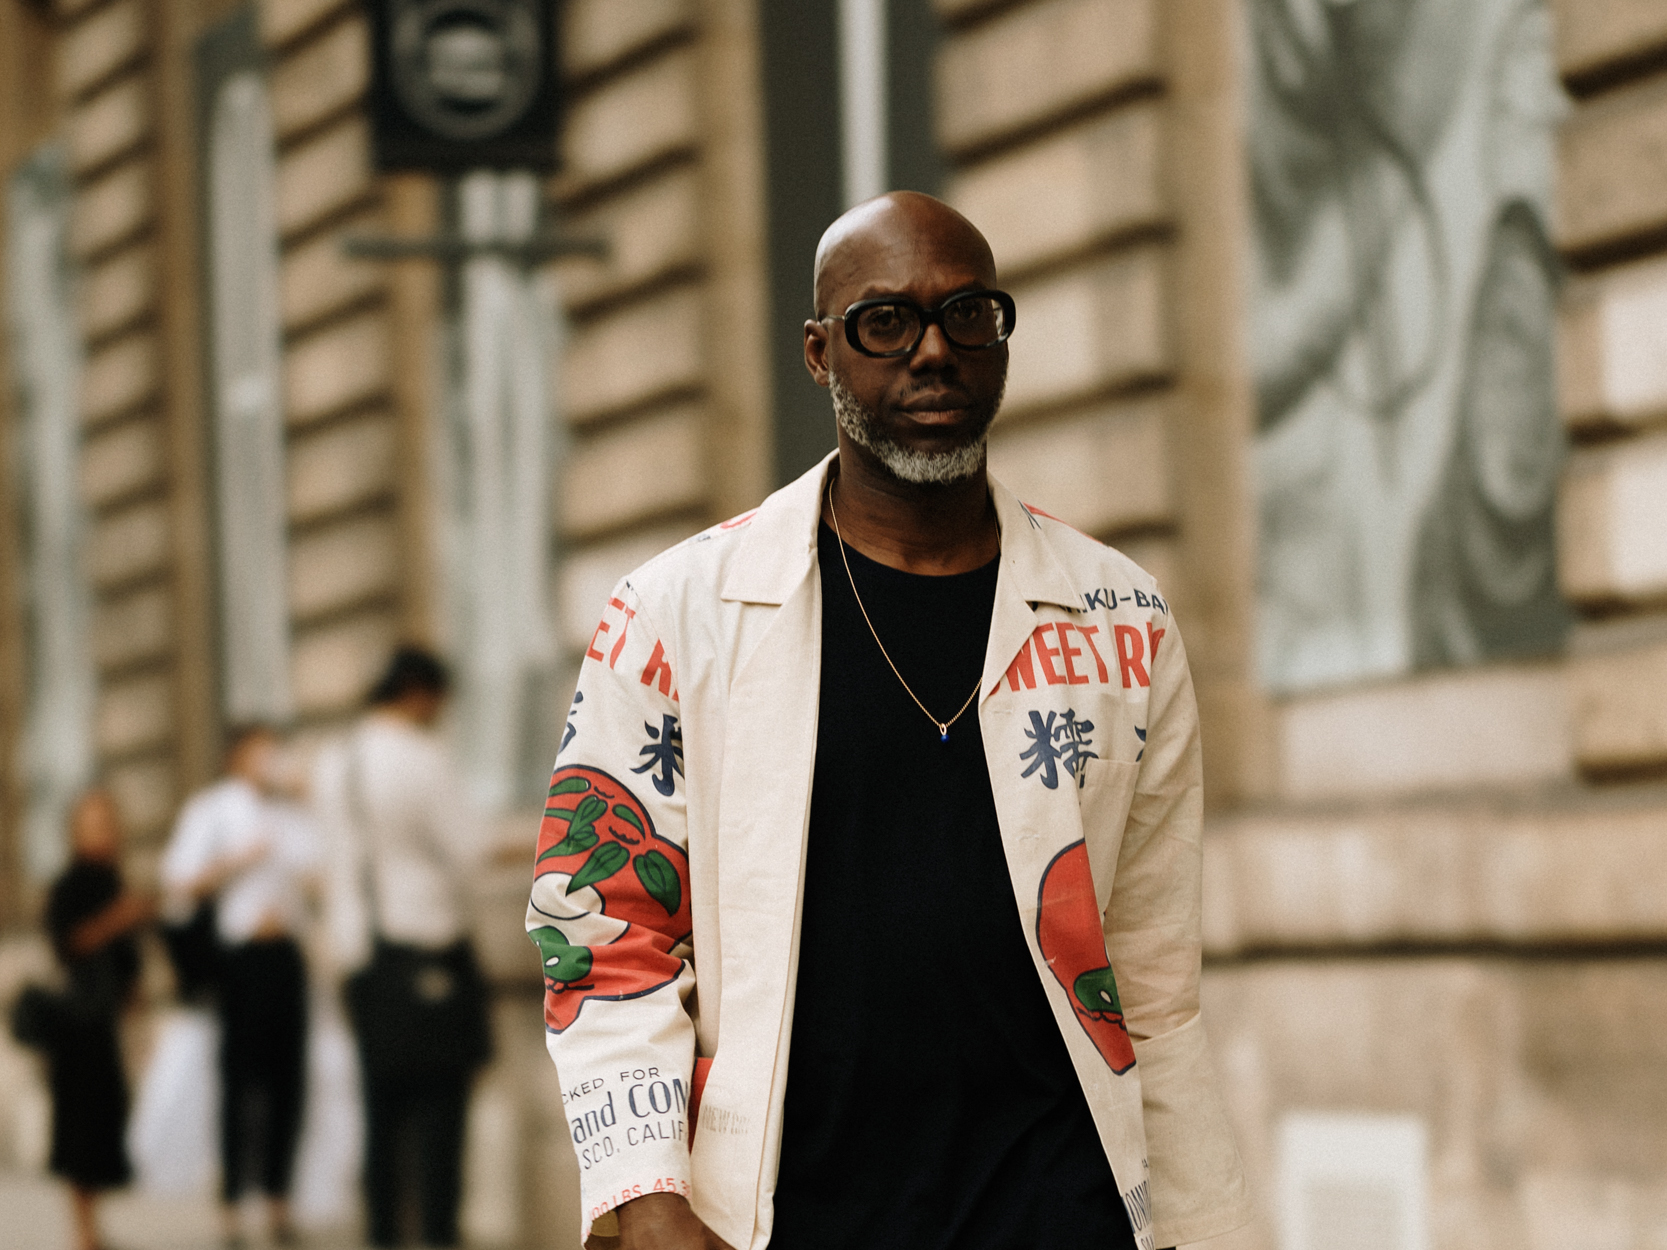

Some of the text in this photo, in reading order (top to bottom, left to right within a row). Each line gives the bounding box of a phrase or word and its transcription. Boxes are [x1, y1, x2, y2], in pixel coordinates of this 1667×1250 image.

[989, 621, 1110, 696] WEET
[620, 1067, 660, 1081] FOR
[571, 1091, 616, 1144] and
